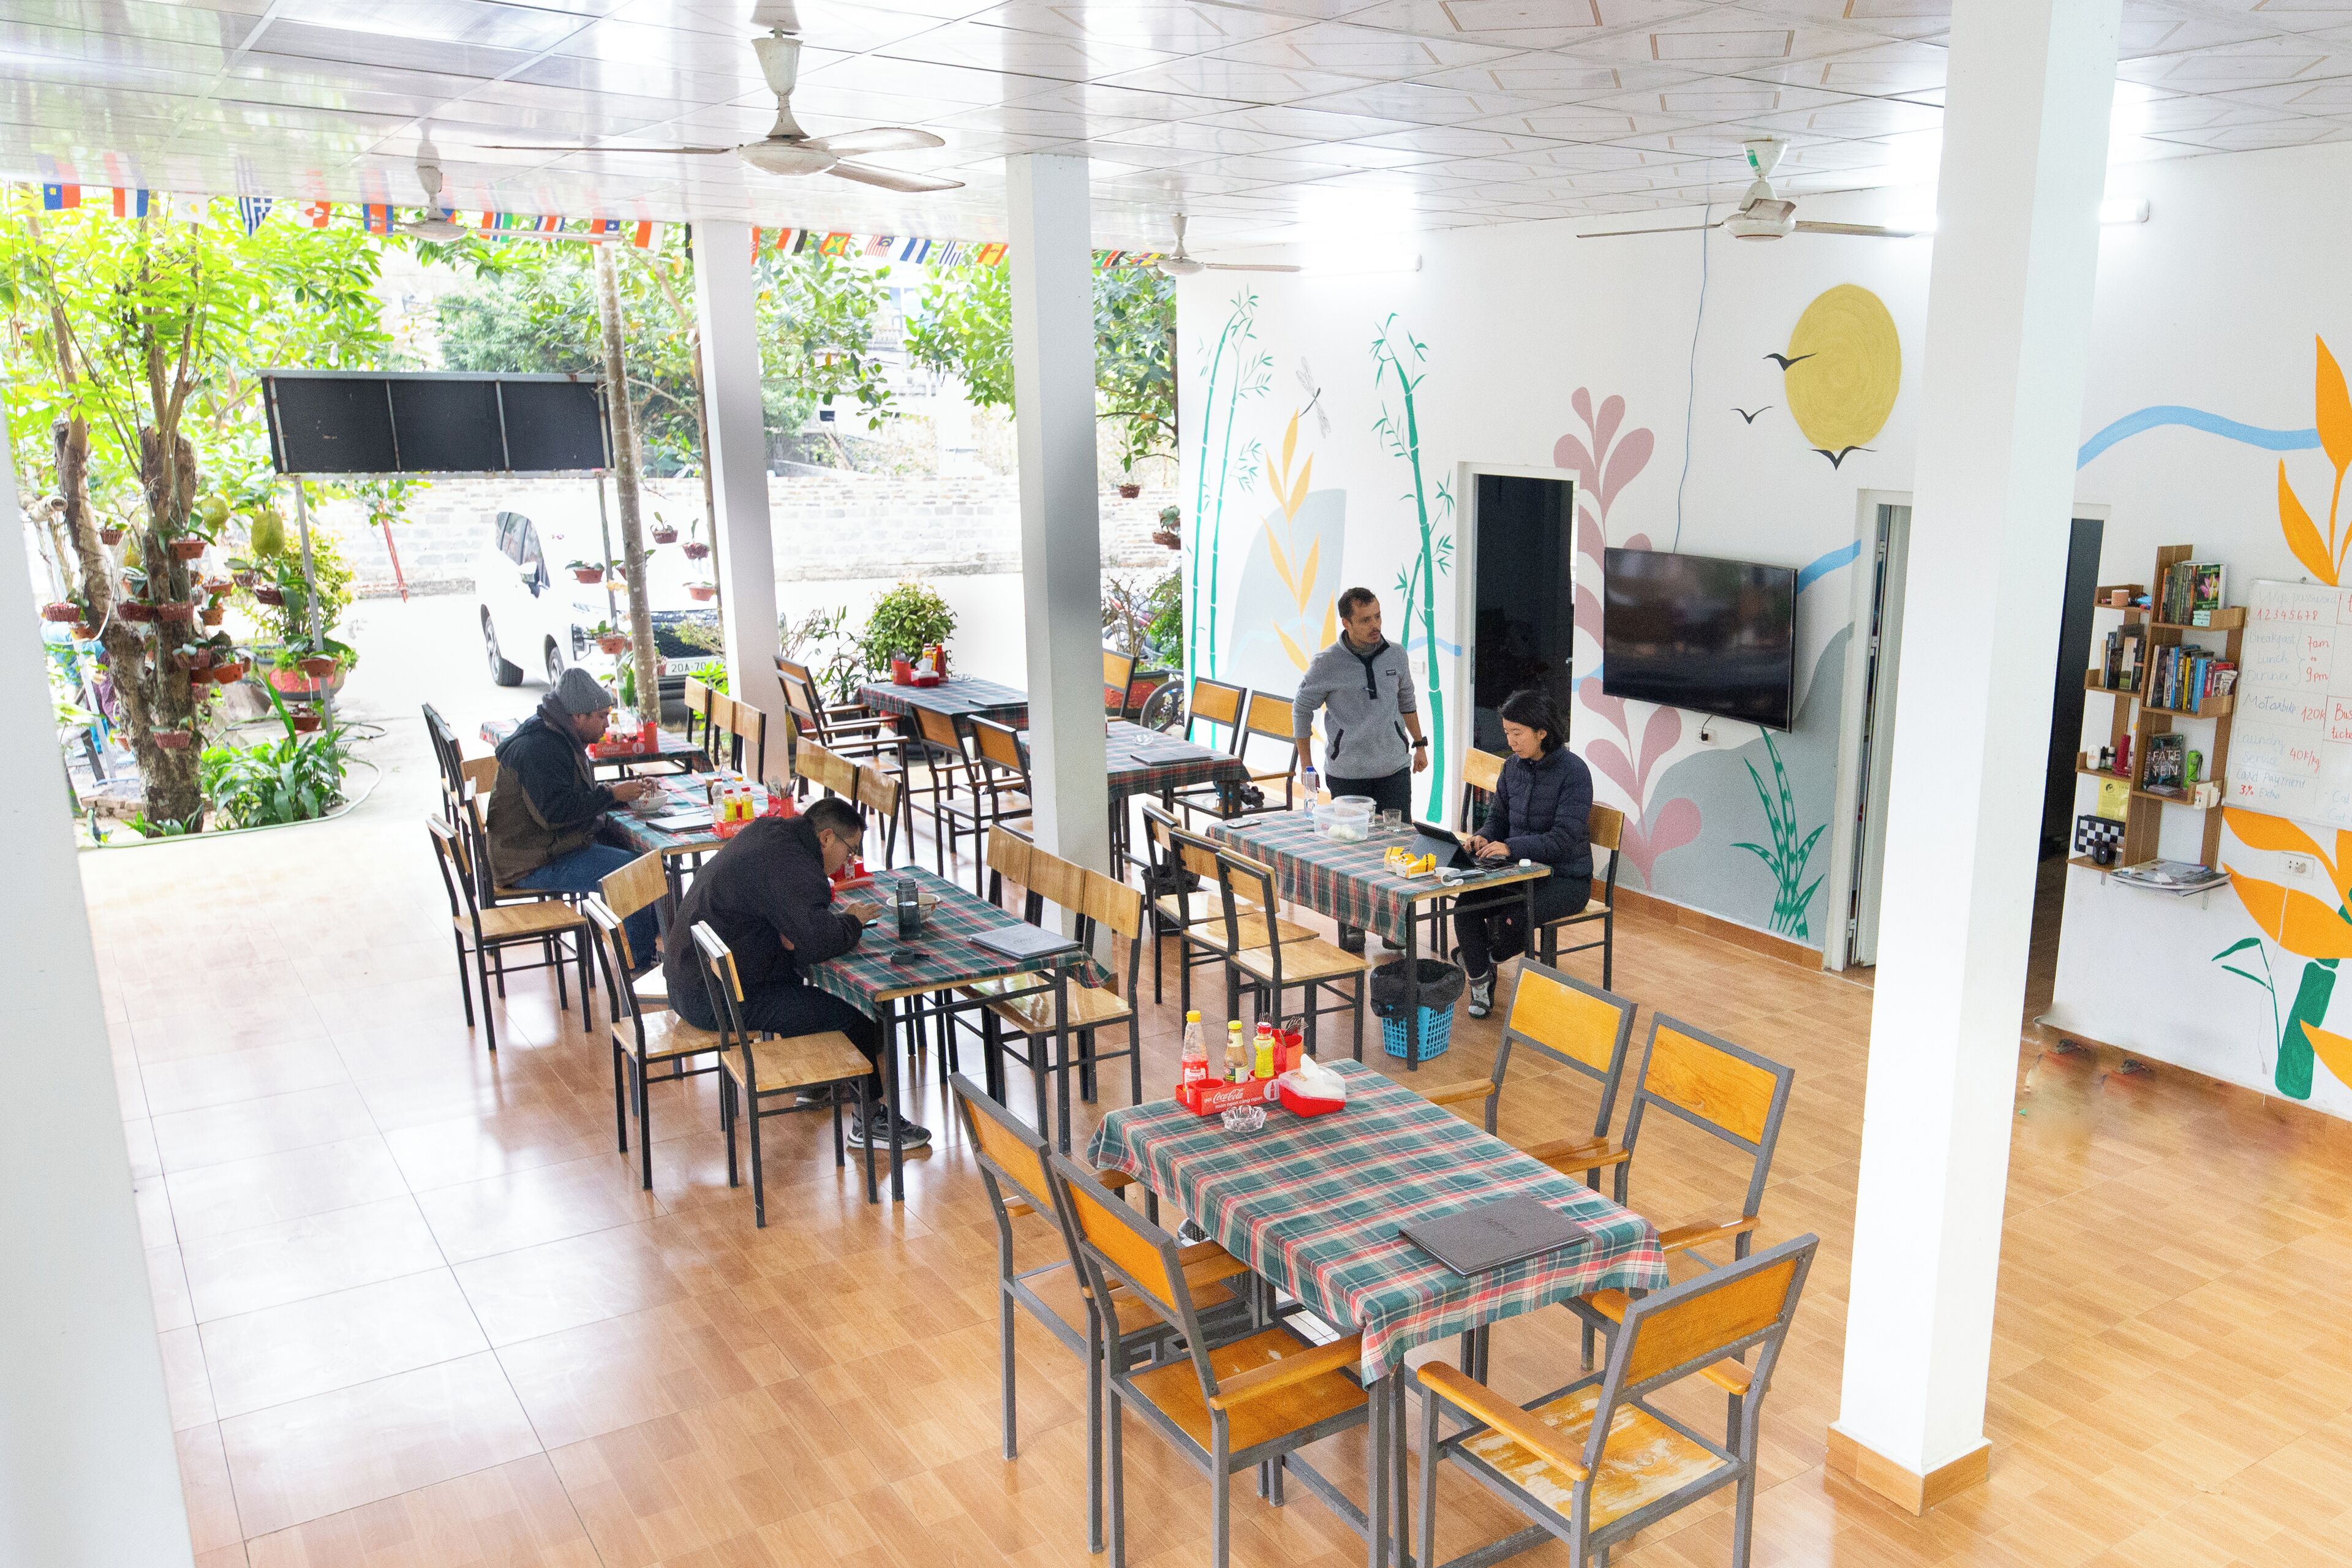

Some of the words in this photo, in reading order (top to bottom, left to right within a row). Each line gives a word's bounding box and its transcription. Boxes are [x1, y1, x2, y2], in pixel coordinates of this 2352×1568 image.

[2256, 608, 2318, 621] 12345678
[2248, 630, 2296, 647] Breakfast
[2307, 635, 2329, 652] 7am
[2257, 650, 2290, 664] Lunch
[2152, 750, 2180, 761] FATE
[2153, 763, 2178, 776] TEN
[2236, 769, 2259, 782] Card
[1213, 1088, 1245, 1104] Coca-Cola
